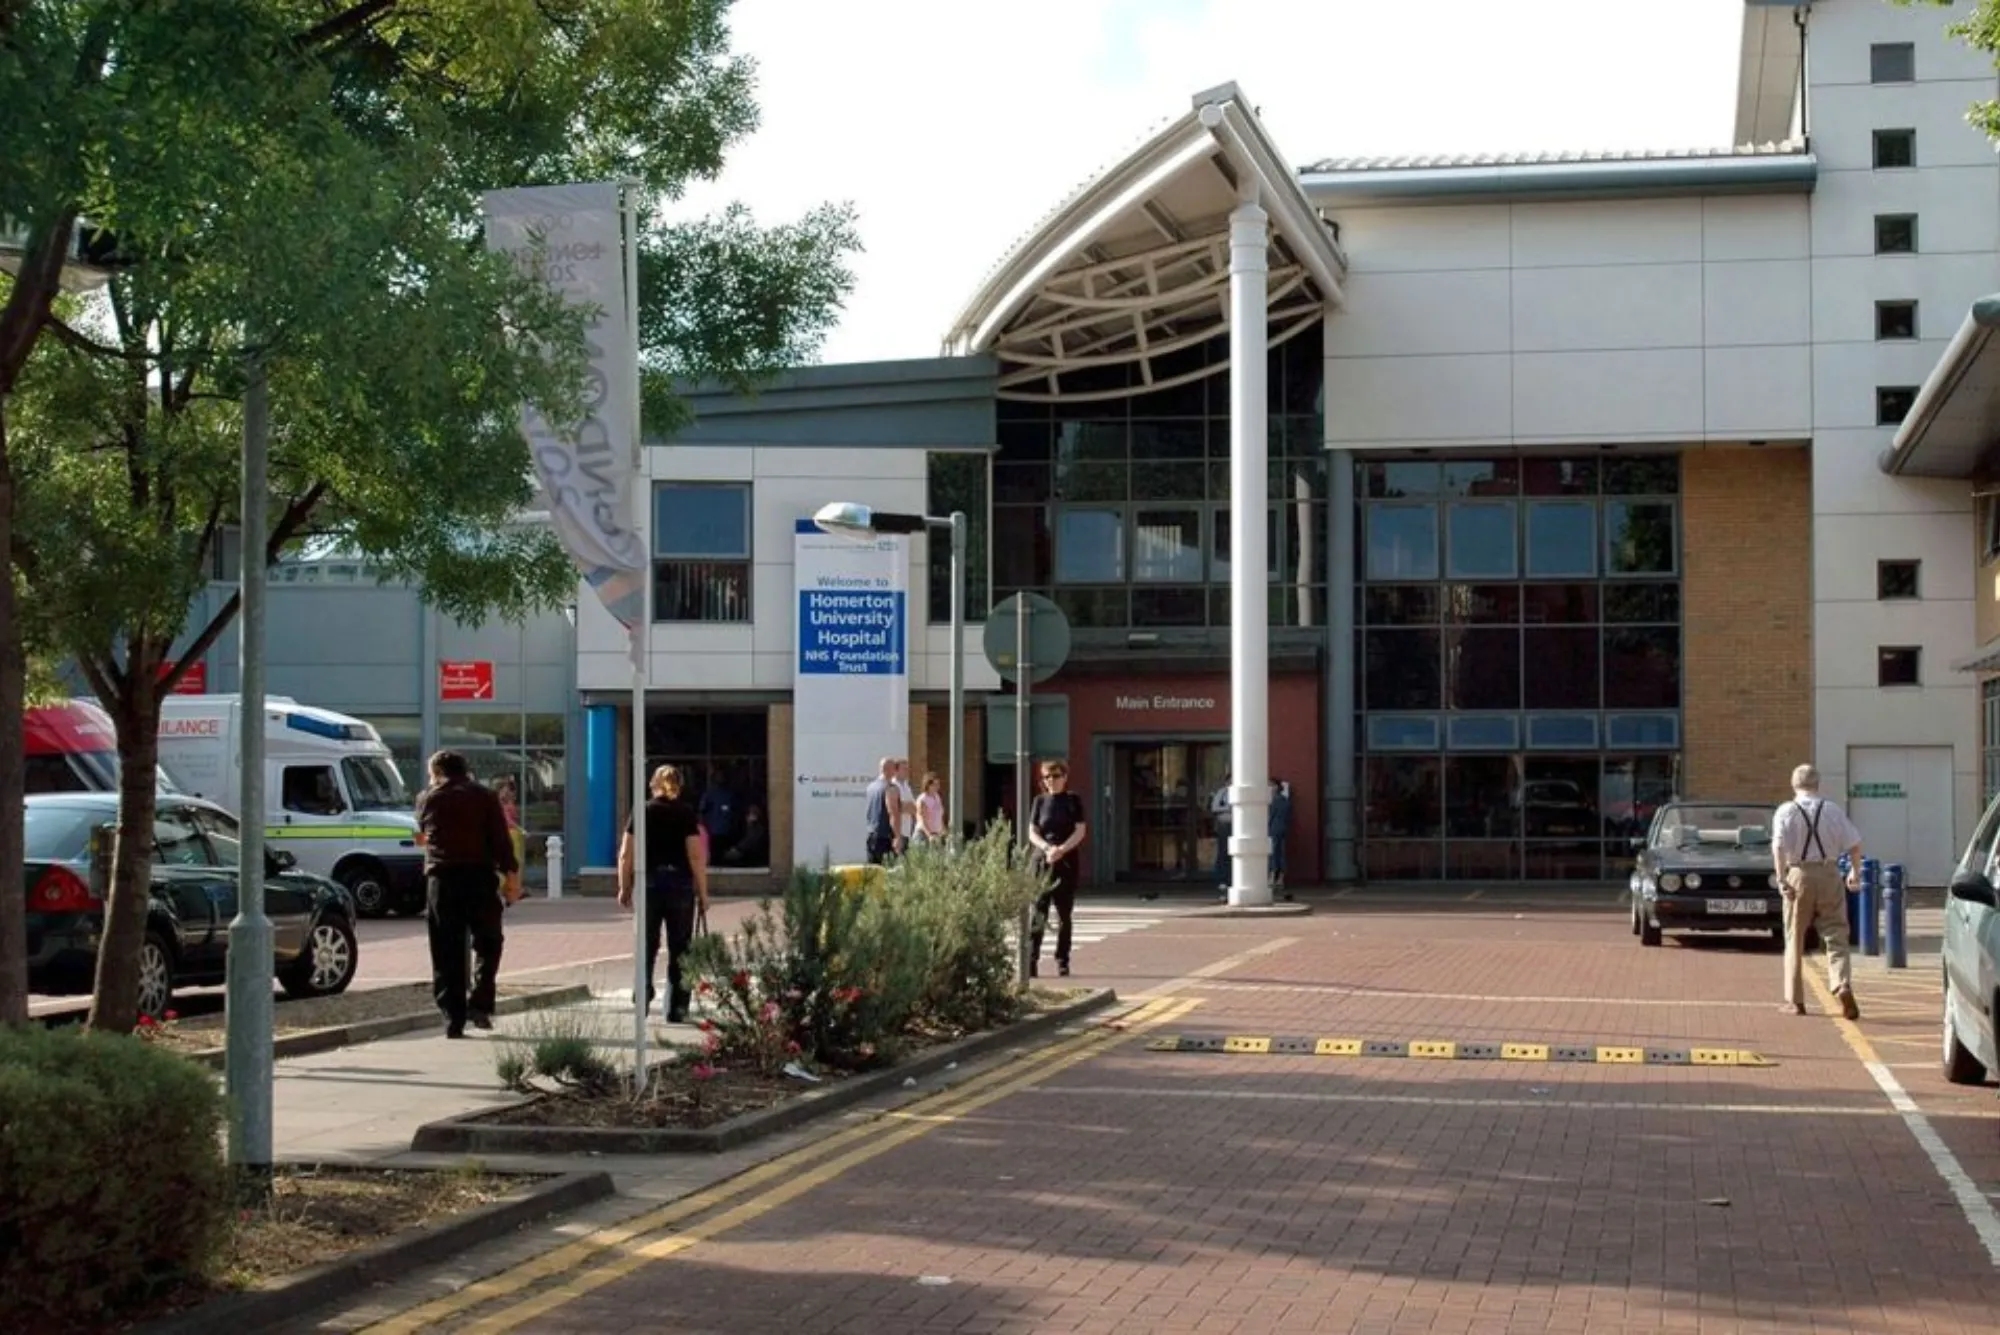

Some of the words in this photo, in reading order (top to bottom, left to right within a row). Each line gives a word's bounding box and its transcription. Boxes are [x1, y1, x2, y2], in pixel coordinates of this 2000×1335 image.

[817, 577, 871, 588] Welcome
[876, 577, 889, 588] to
[810, 594, 895, 609] Homerton
[810, 611, 894, 629] University
[818, 631, 886, 648] Hospital
[805, 651, 828, 662] NHS
[833, 650, 899, 662] Foundation
[838, 661, 868, 673] Trust
[1116, 696, 1149, 708] Main
[1154, 696, 1215, 708] Entrance
